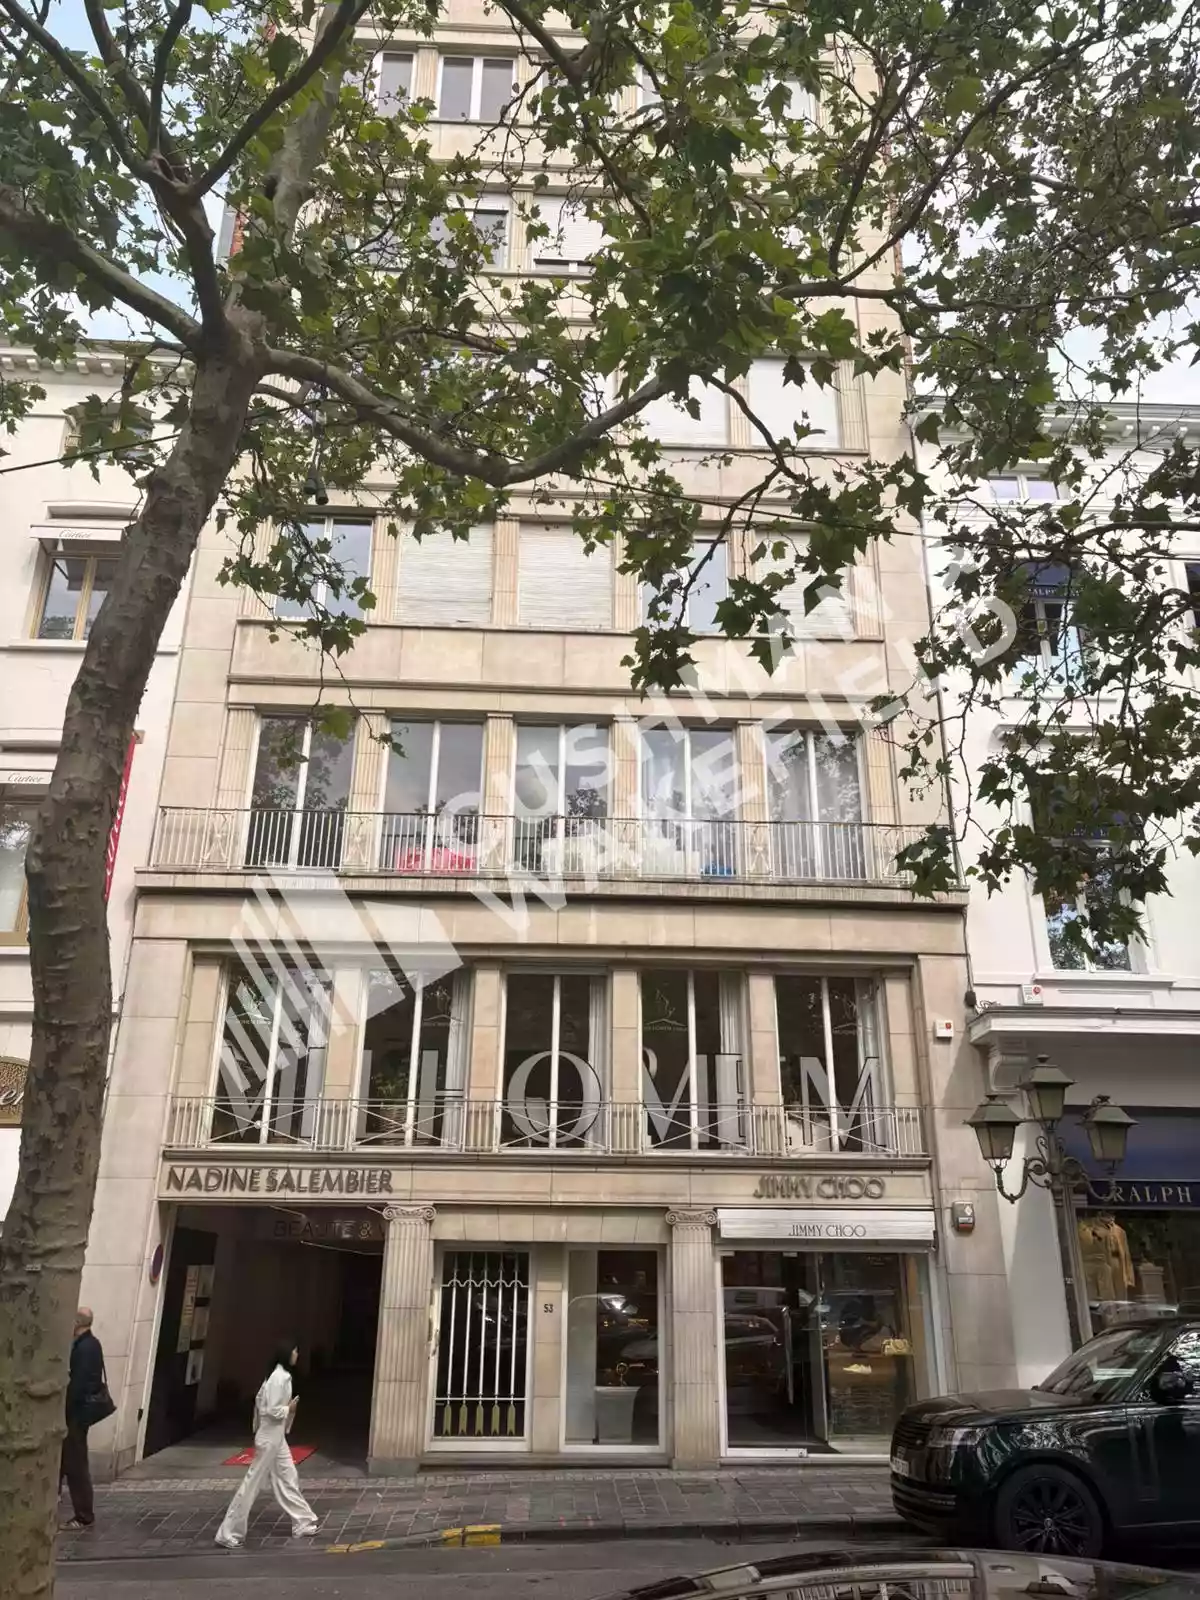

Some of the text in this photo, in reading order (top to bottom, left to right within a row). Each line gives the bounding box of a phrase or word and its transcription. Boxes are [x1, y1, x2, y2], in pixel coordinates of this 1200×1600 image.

[8, 772, 44, 782] Cartier
[166, 1167, 393, 1194] NADINE SALEMBIER
[753, 1175, 885, 1199] JIMMY CHOO
[1112, 1185, 1192, 1203] RALPH
[788, 1224, 867, 1238] JIMMY CHOO
[543, 1303, 554, 1313] 53
